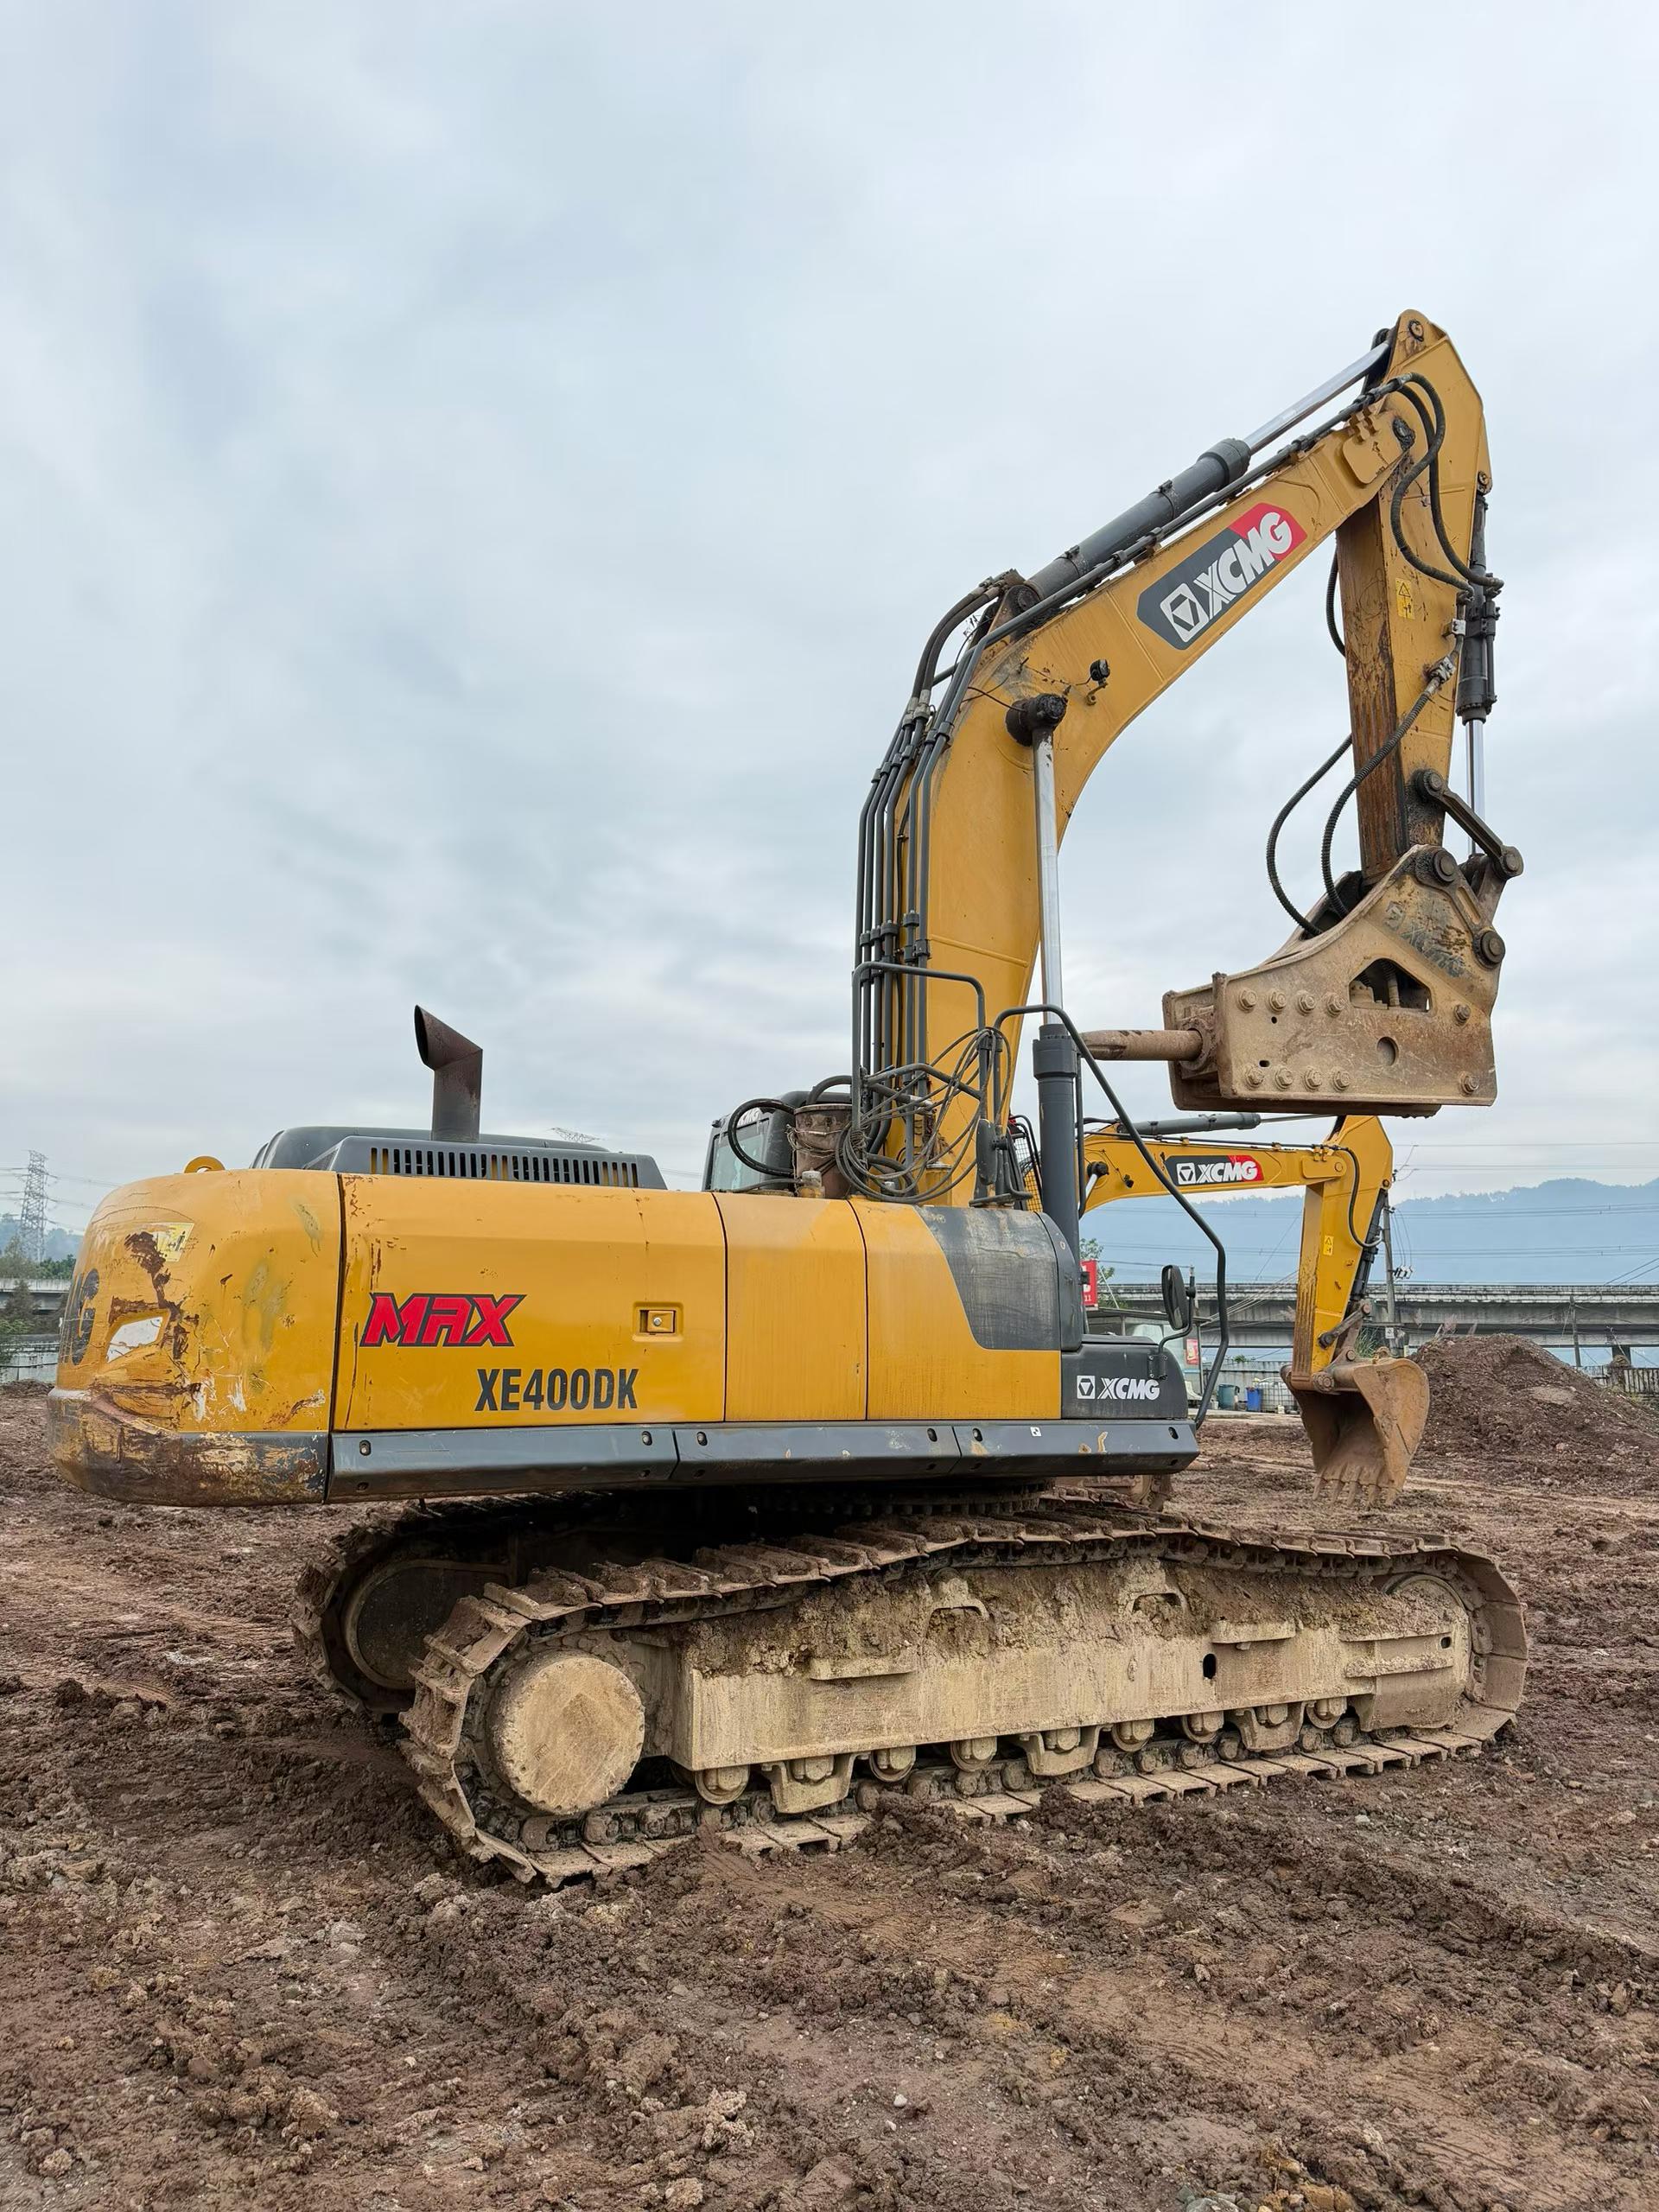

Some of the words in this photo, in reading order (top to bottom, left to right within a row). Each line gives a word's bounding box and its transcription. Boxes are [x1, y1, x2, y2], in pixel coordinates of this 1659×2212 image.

[1193, 512, 1293, 620] XCMG
[1196, 1160, 1258, 1184] XCMG
[359, 1293, 527, 1347] MAX
[474, 1368, 639, 1411] XE400DK
[1097, 1377, 1160, 1401] XCMG
